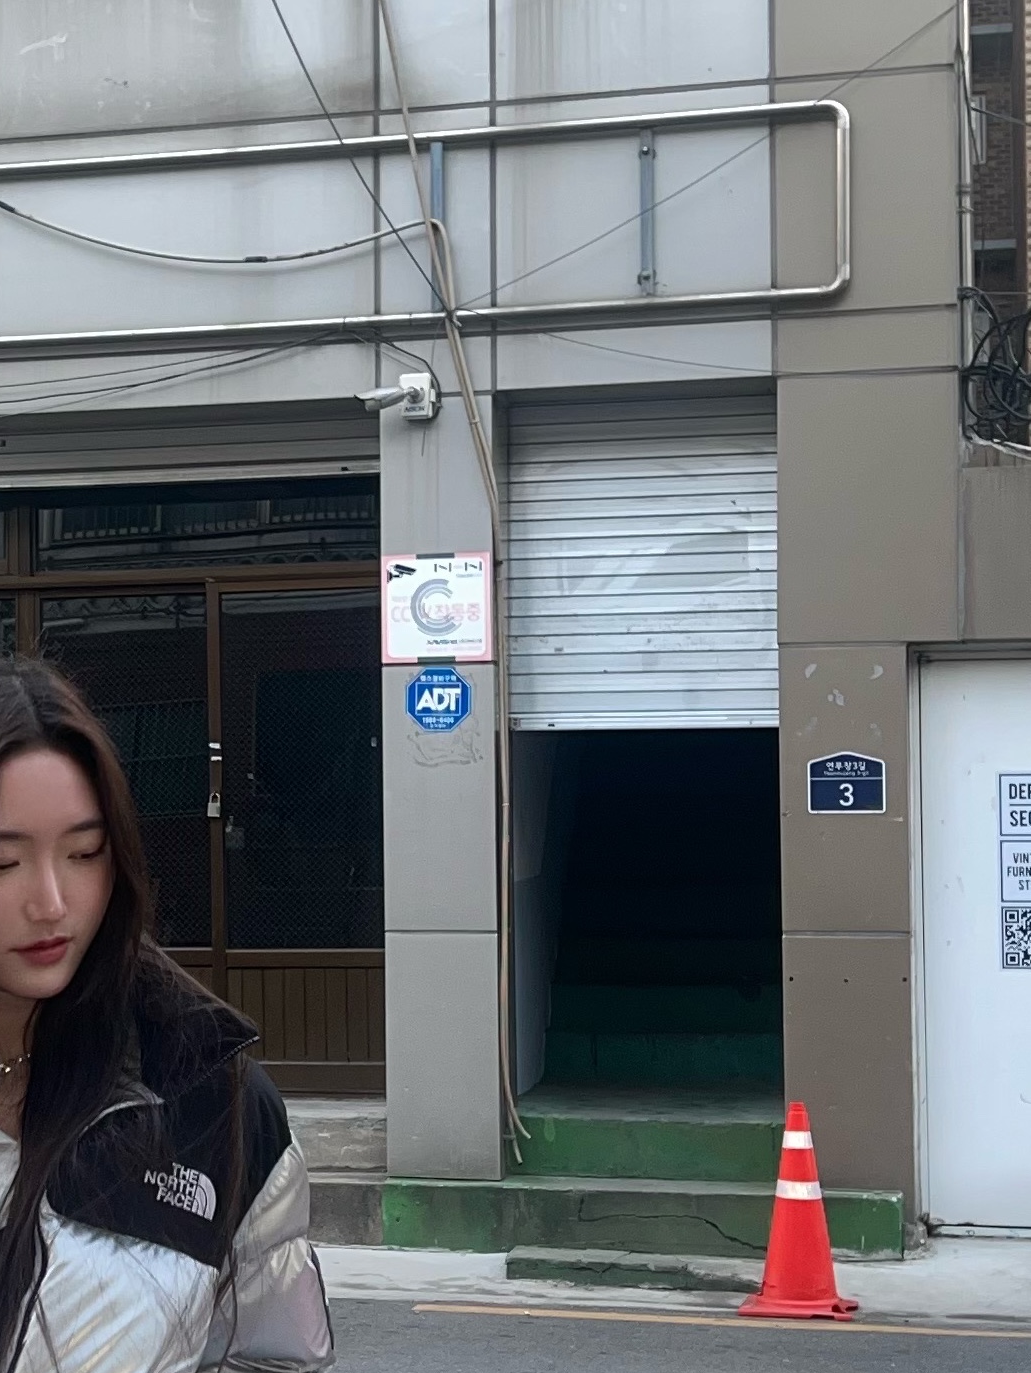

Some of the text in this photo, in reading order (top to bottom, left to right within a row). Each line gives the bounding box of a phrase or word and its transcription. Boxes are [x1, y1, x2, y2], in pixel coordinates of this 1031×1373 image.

[416, 687, 461, 711] ADT
[839, 783, 854, 806] 3
[144, 1169, 197, 1198] NORTH
[172, 1162, 199, 1185] THE
[156, 1186, 194, 1211] FACE
